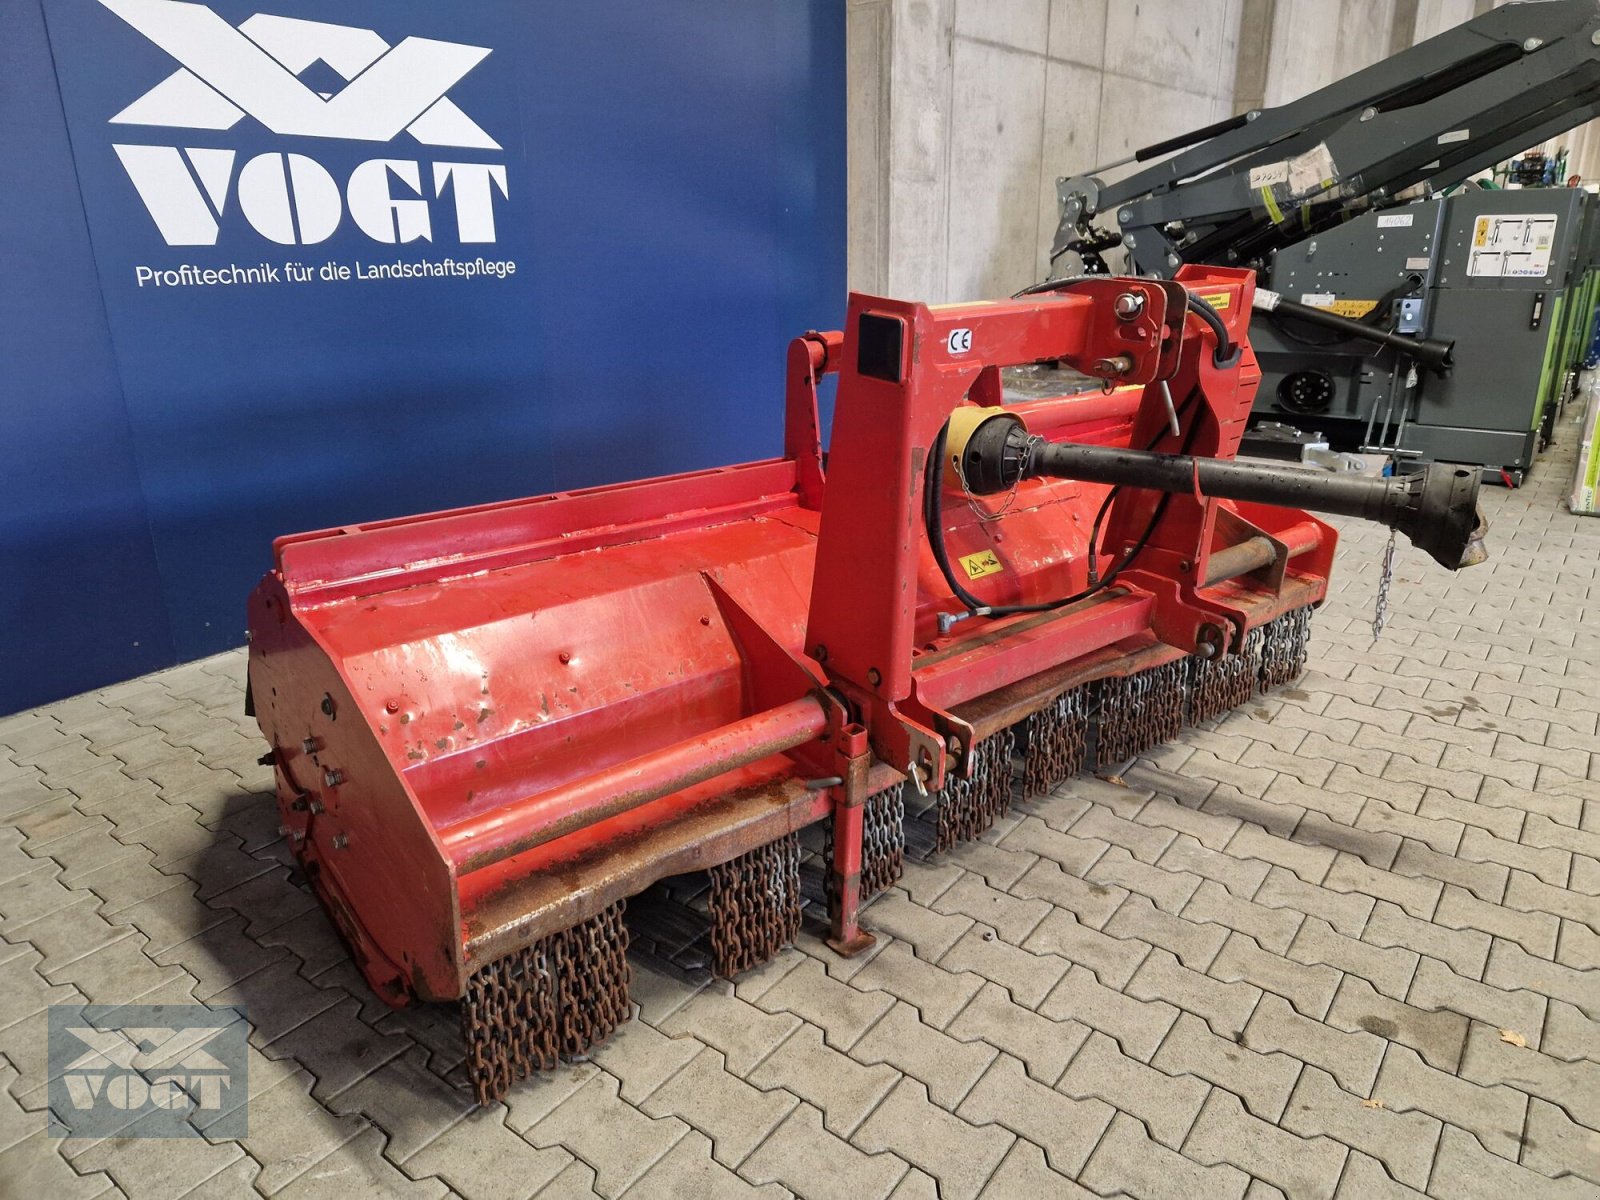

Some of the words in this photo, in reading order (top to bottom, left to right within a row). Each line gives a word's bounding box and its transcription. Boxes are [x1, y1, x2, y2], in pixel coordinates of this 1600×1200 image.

[112, 144, 509, 245] VOGT
[135, 262, 280, 287] Profitechnik
[284, 262, 315, 282] für
[319, 261, 351, 281] die
[356, 257, 516, 279] Landschaftspflege
